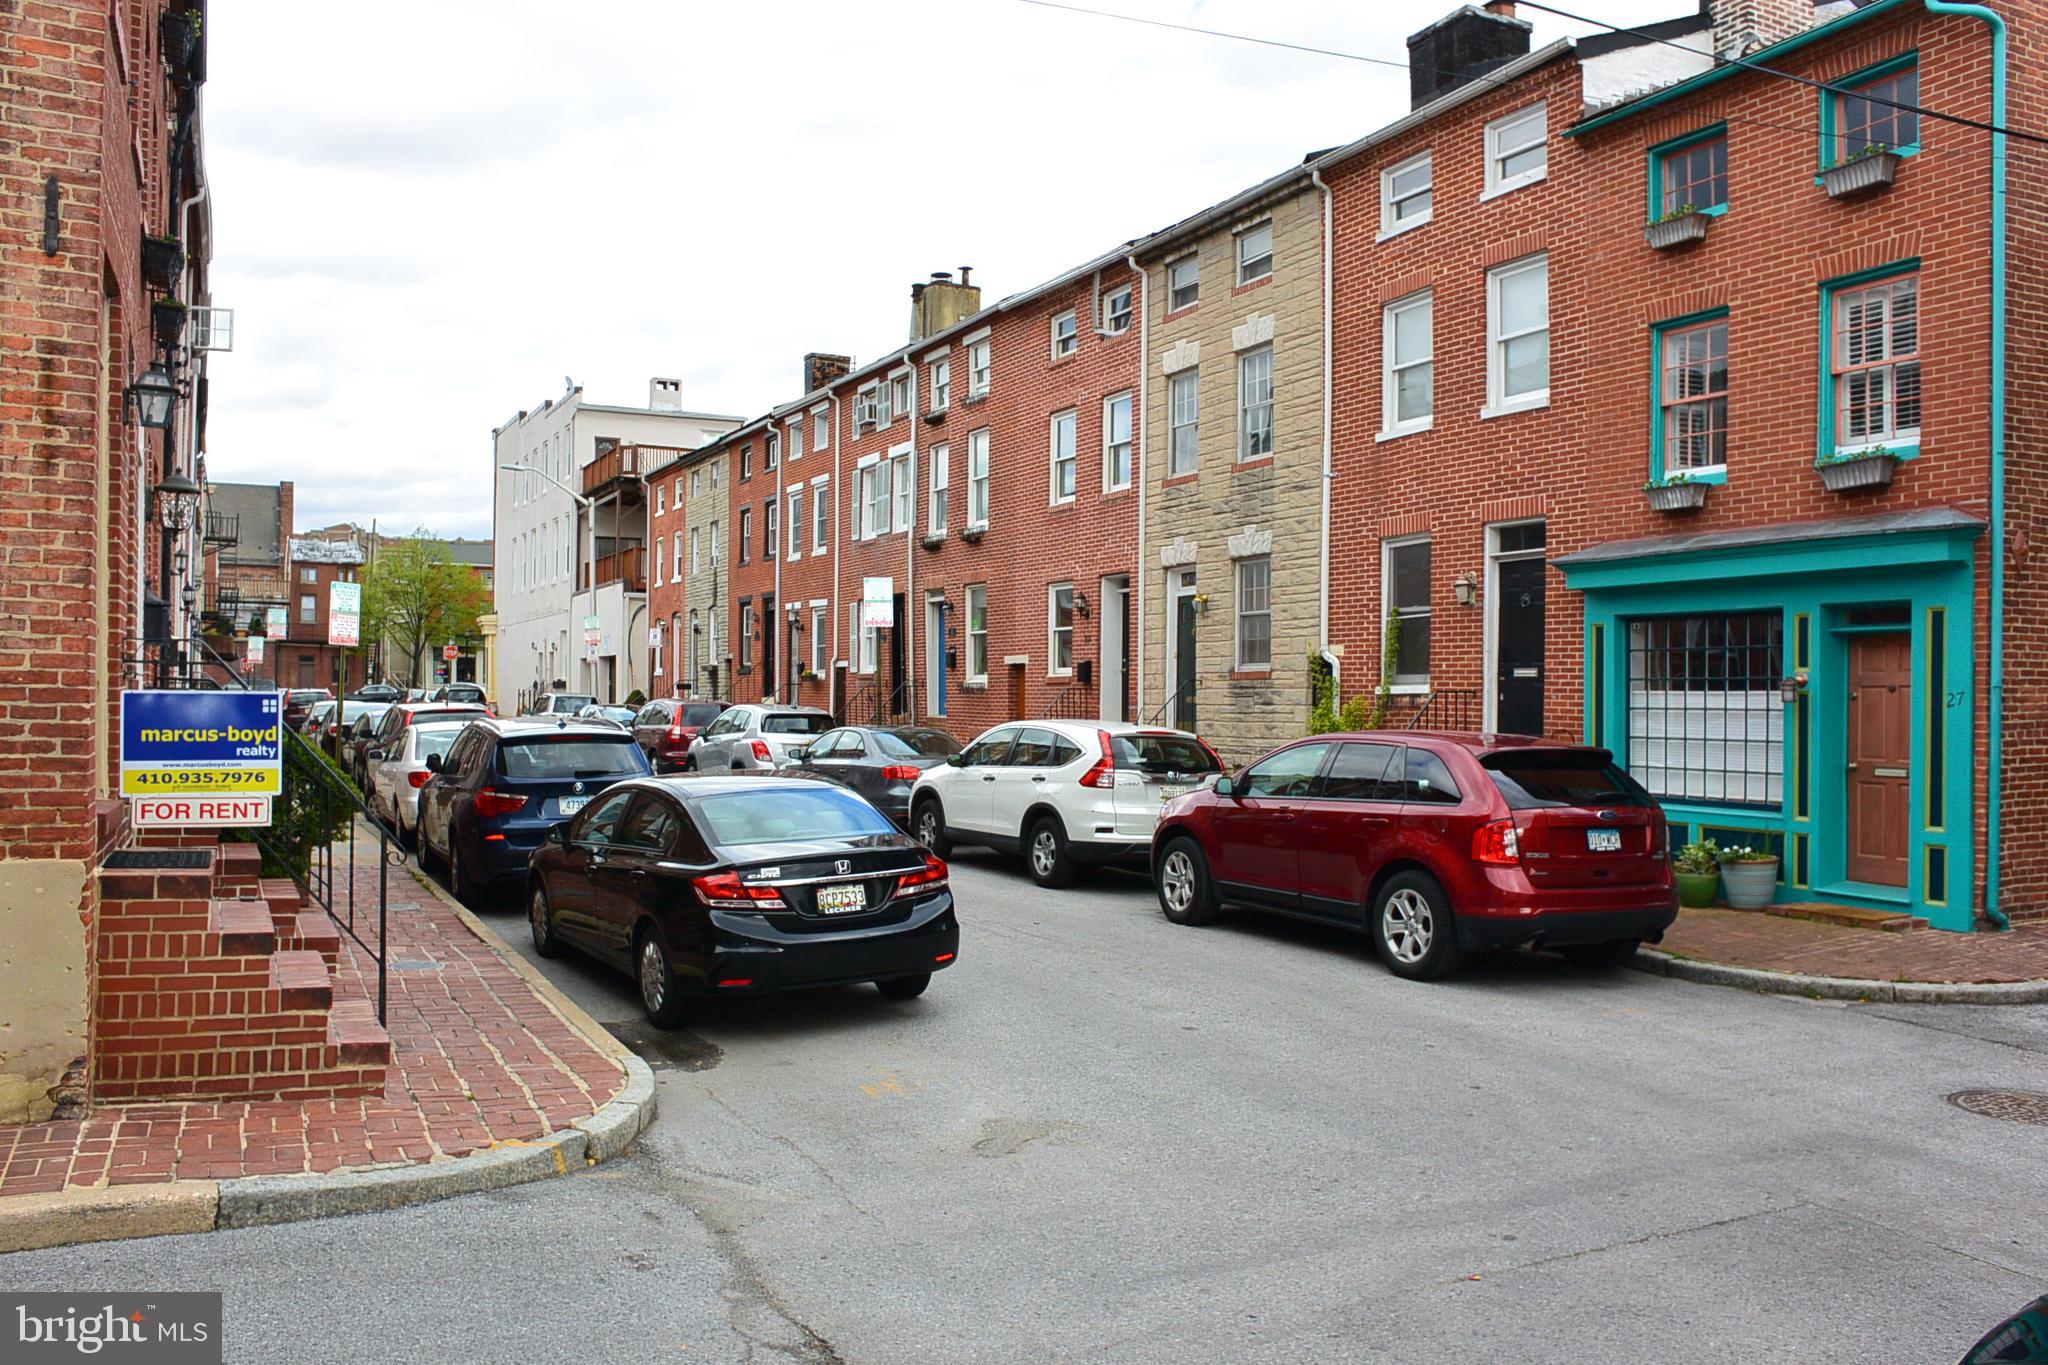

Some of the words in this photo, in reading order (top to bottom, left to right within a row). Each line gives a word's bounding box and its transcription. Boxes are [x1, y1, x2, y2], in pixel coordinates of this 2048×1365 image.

[1947, 691, 1965, 708] 27
[141, 725, 277, 744] marcus-boyd
[236, 745, 276, 758] realty
[162, 761, 242, 769] www.marcusboyd.com
[137, 771, 265, 785] 410.935.7976
[140, 803, 191, 820] FOR
[199, 802, 264, 819] RENT
